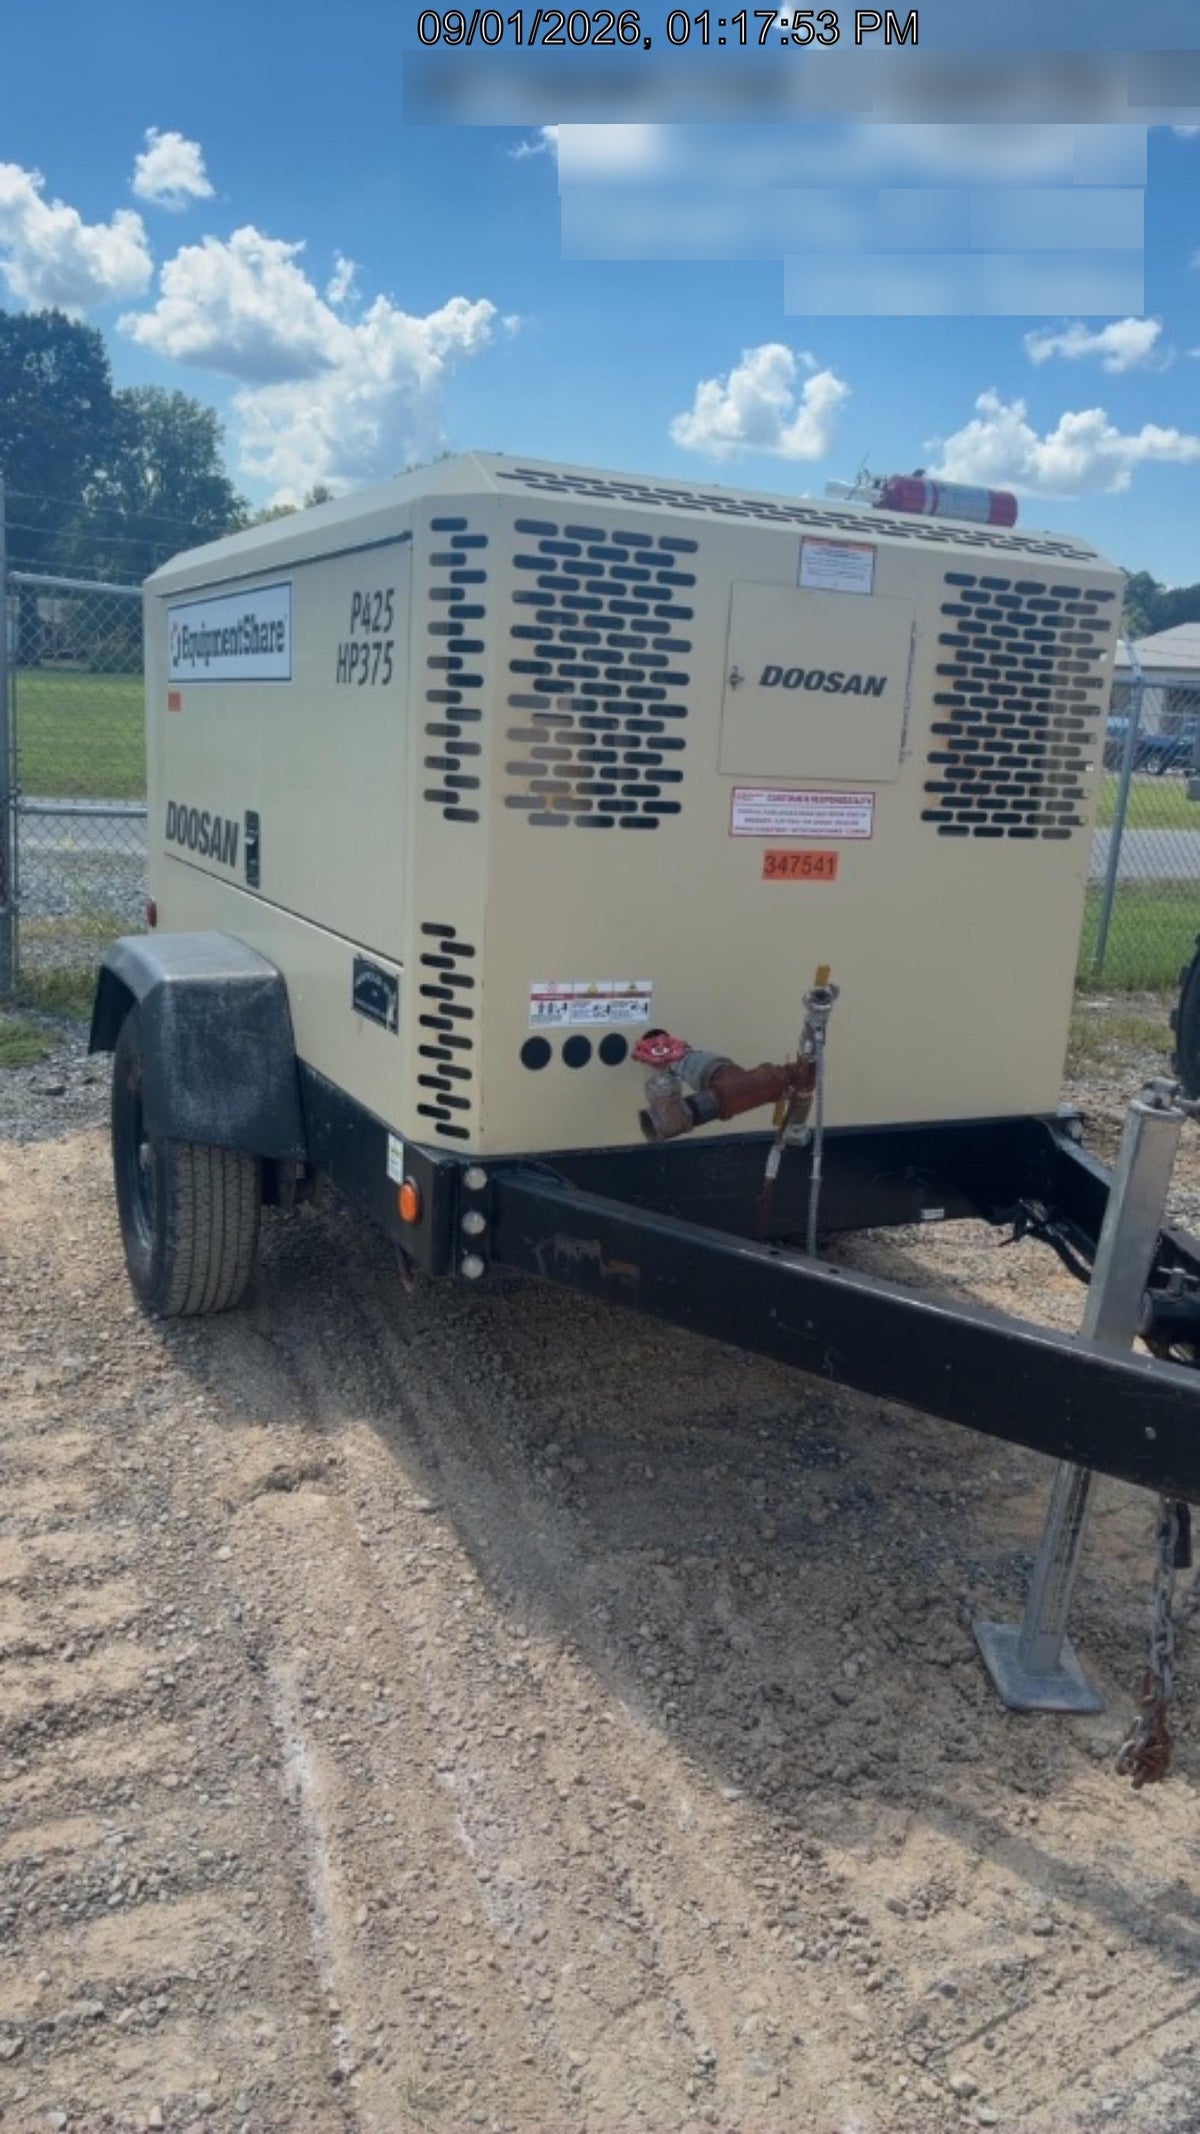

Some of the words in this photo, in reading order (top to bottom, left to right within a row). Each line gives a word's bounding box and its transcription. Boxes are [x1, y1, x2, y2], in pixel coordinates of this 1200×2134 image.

[350, 588, 394, 634] P425
[182, 613, 286, 667] EquipmentShare
[336, 640, 394, 685] HP375
[759, 665, 887, 697] DOOSAN
[166, 800, 239, 868] DOOSAN
[764, 855, 834, 875] 347541
